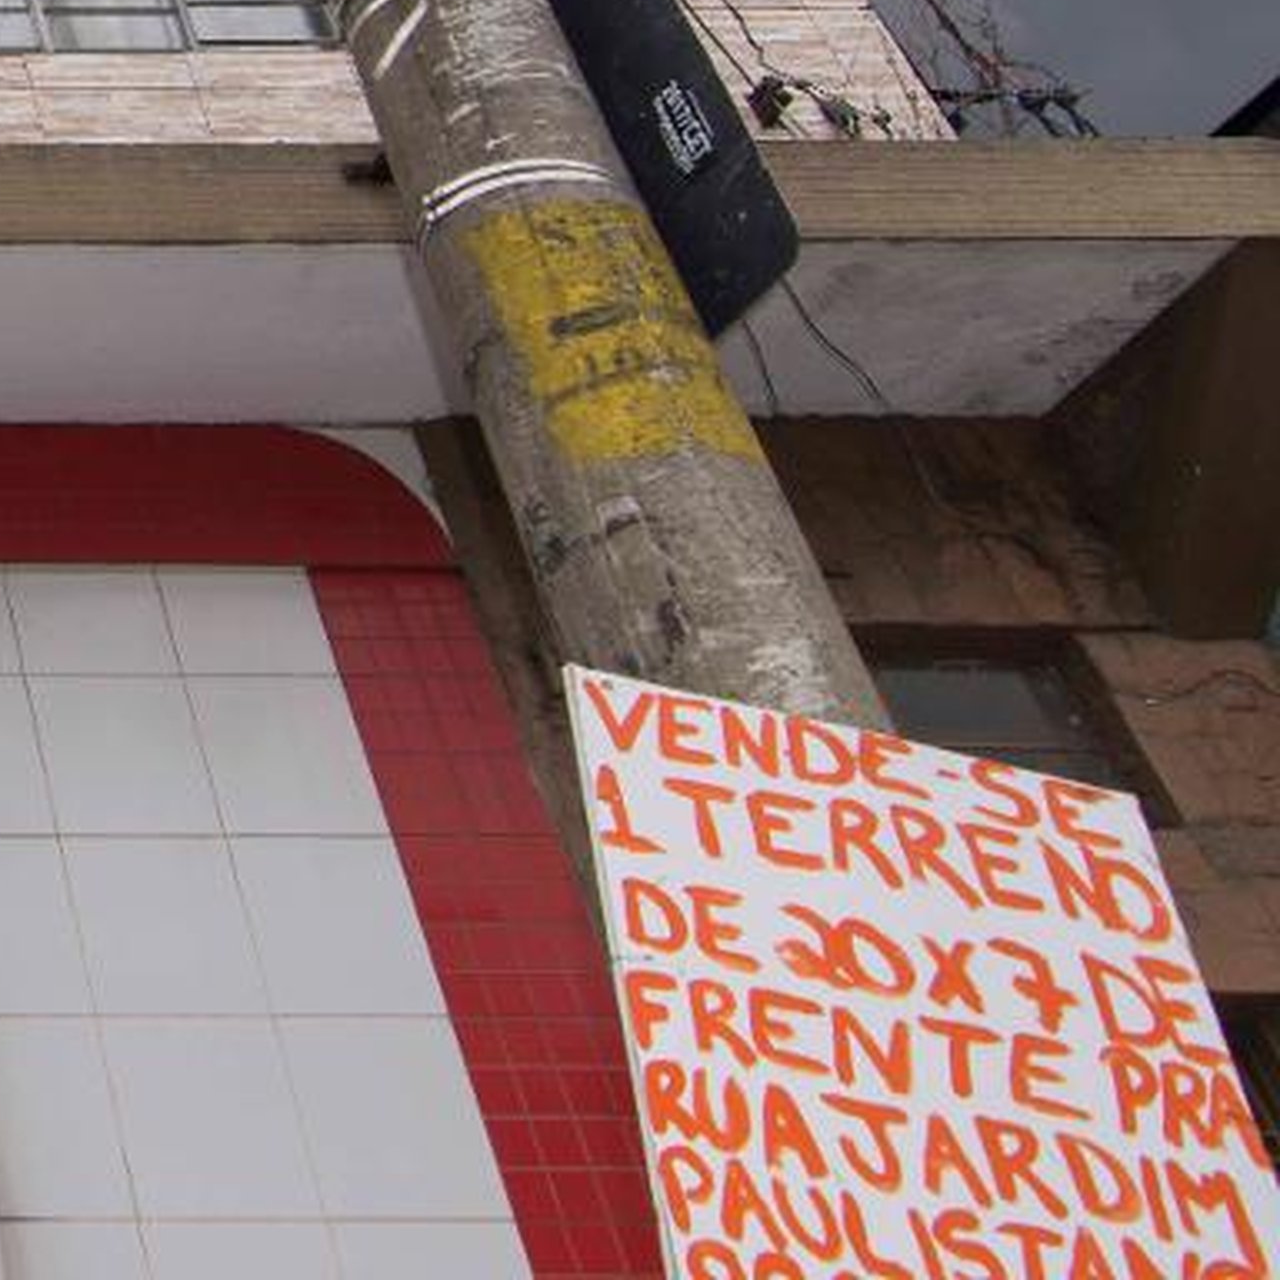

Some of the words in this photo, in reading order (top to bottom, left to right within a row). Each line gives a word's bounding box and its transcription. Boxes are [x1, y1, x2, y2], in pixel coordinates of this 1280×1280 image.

[585, 680, 1126, 849] VENDE-SE
[595, 768, 666, 854] 1
[623, 878, 761, 974] DE
[1083, 952, 1240, 1068] DE
[623, 970, 1093, 1121] FRENTE
[1100, 1042, 1274, 1173] PRA
[644, 1058, 829, 1181] RUA
[820, 1092, 1270, 1276] JARDIM
[656, 1143, 1270, 1280] PAULISTAN
